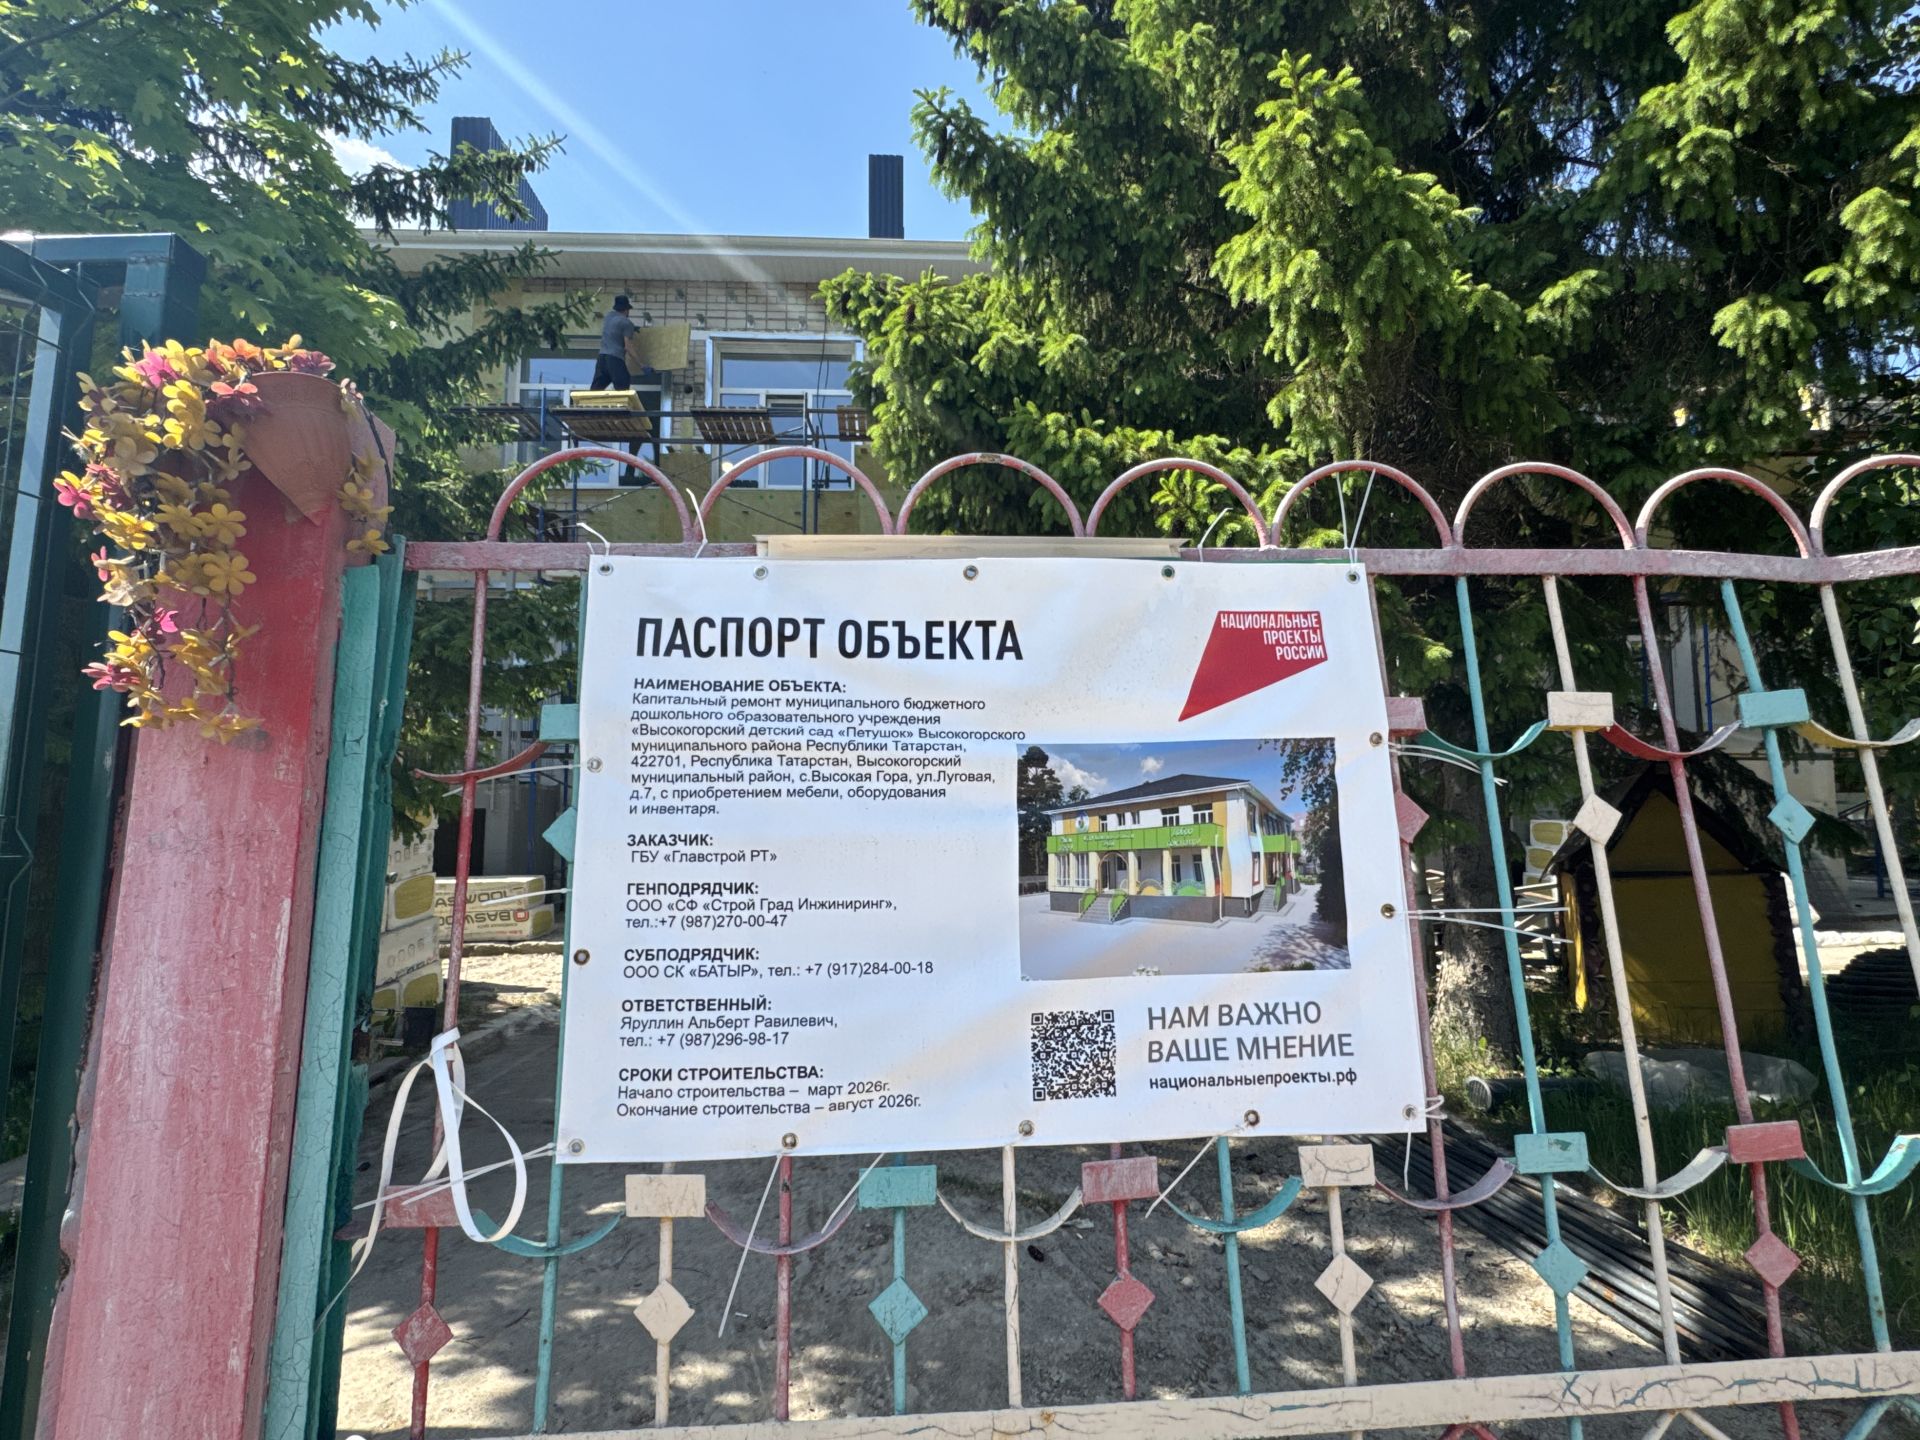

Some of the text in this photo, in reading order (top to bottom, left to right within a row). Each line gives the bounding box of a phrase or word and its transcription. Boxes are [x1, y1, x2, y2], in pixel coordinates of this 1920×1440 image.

[1220, 613, 1319, 630] НАЦИОНАЛЬНЫЕ
[637, 617, 1023, 660] ПАСПОРТ ОБЪЕКТА
[1263, 629, 1321, 645] ПРОЕКТЫ
[1275, 645, 1325, 661] РОССИИ
[634, 678, 846, 693] НАИМЕНОВАНИЕ ОБЪЕКТА:
[633, 693, 985, 711] Капитальный ремонт муниципального бюджетного
[631, 711, 940, 726] дошкольного образовательного учреждения
[632, 724, 1025, 741] «Высокогорский детский сад «Петушок» Высокогорского
[632, 740, 966, 754] муниципального района Республики Татарстан,
[631, 755, 961, 769] 422701, Республика Татарстан, Высокогорский
[632, 770, 995, 786] муниципальный район, с.Высокая Гора, ул.Луговая,
[630, 786, 946, 801] д.7, с приобретением мебели, оборудования
[629, 805, 719, 816] и инвентаря.
[627, 834, 713, 846] ЗАКАЗЧИК:
[632, 850, 777, 865] ГБУ «Главстрой РТ»
[627, 882, 758, 897] ГЕНПОДРЯДЧИК:
[434, 890, 509, 907] ASWOOL
[626, 898, 896, 913] ООО «СФ «Строй Град Инжиниринг»,
[626, 915, 787, 930] тел.:+7 (987)270-00-47
[624, 948, 759, 963] СУБПОДРЯДЧИК:
[624, 961, 933, 979] ООО СК «БАТЫР», тел.: +7 (917)284-00-18
[622, 997, 771, 1012] ОТВЕТСТВЕННЫЙ:
[621, 1015, 837, 1032] Яруллин Альберт Равилевич,
[1148, 1001, 1321, 1030] НАМ ВАЖНО
[620, 1032, 789, 1049] тел.: +7 (987)296-98-17
[1148, 1034, 1354, 1063] ВАШЕ МНЕНИЕ
[619, 1066, 823, 1081] СРОКИ СТРОИТЕЛЬСТВА:
[1150, 1068, 1357, 1091] национальныепроекты.рф
[618, 1086, 672, 1099] Начало
[678, 1087, 784, 1101] строительства
[808, 1086, 843, 1098] март
[848, 1081, 889, 1094] 2026г.
[617, 1103, 697, 1116] Окончание
[703, 1103, 810, 1118] строительства
[829, 1099, 874, 1112] август
[879, 1094, 921, 1108] 2026г.
